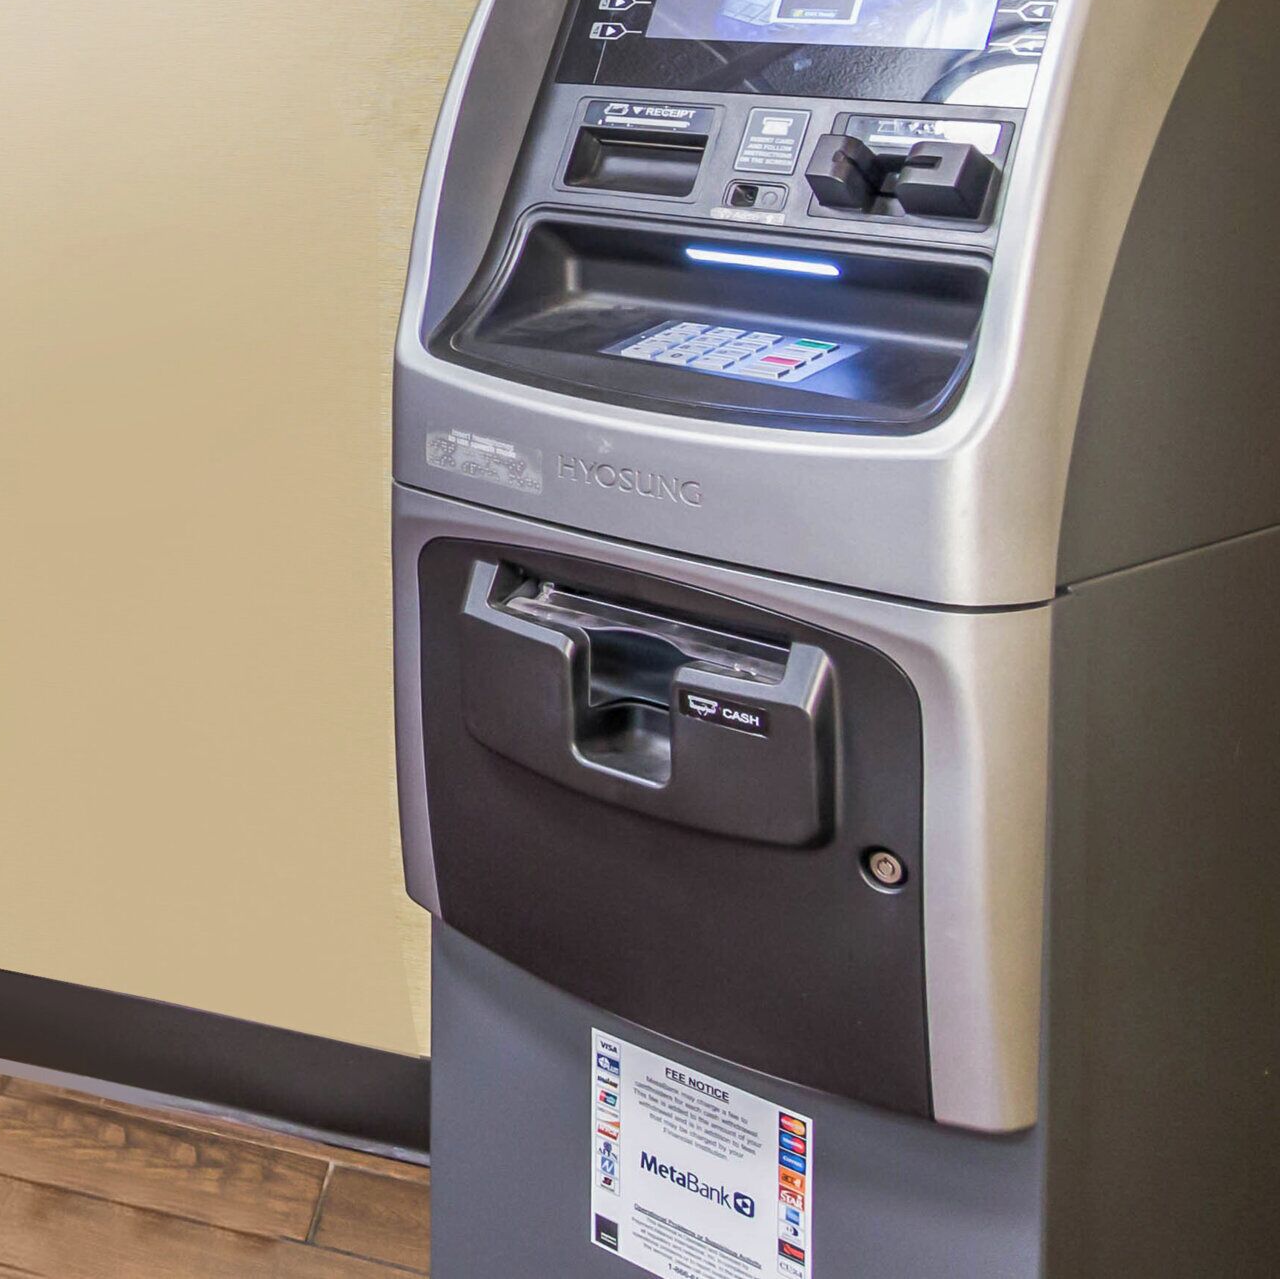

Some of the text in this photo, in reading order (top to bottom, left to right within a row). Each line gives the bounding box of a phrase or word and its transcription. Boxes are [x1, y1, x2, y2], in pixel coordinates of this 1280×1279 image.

[645, 107, 696, 119] RECEIPT
[557, 454, 703, 508] HYOSUNG
[722, 708, 760, 727] CASH
[600, 1041, 617, 1053] VISA
[665, 1067, 730, 1102] FEE NOTICE
[640, 1151, 732, 1210] MetaBank
[780, 1190, 803, 1210] STAR
